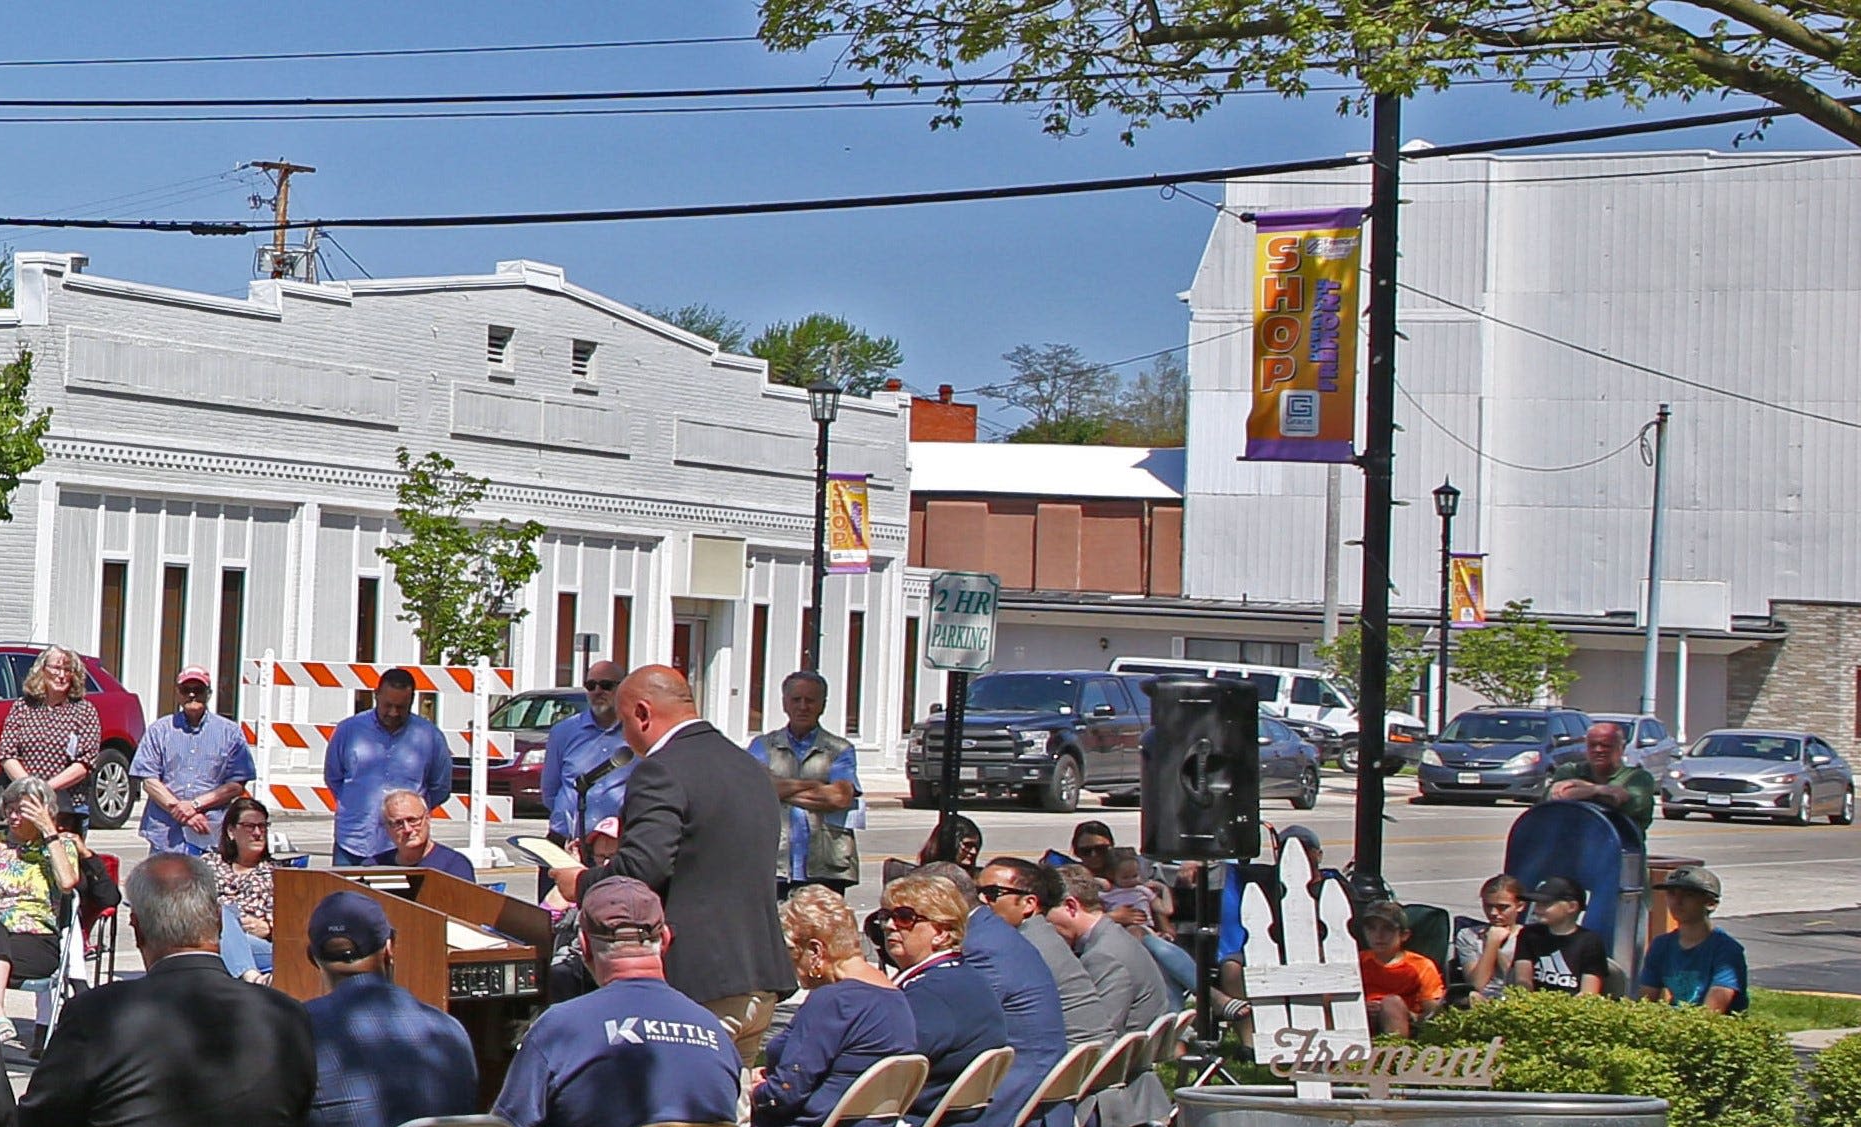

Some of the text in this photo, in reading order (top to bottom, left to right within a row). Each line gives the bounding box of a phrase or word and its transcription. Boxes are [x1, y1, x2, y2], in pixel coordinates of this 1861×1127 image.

[1261, 235, 1305, 392] SHOP
[934, 589, 991, 616] 2 HR
[931, 624, 989, 651] PARKING
[643, 1019, 718, 1044] KITTLE
[1270, 1027, 1509, 1079] Fremont
